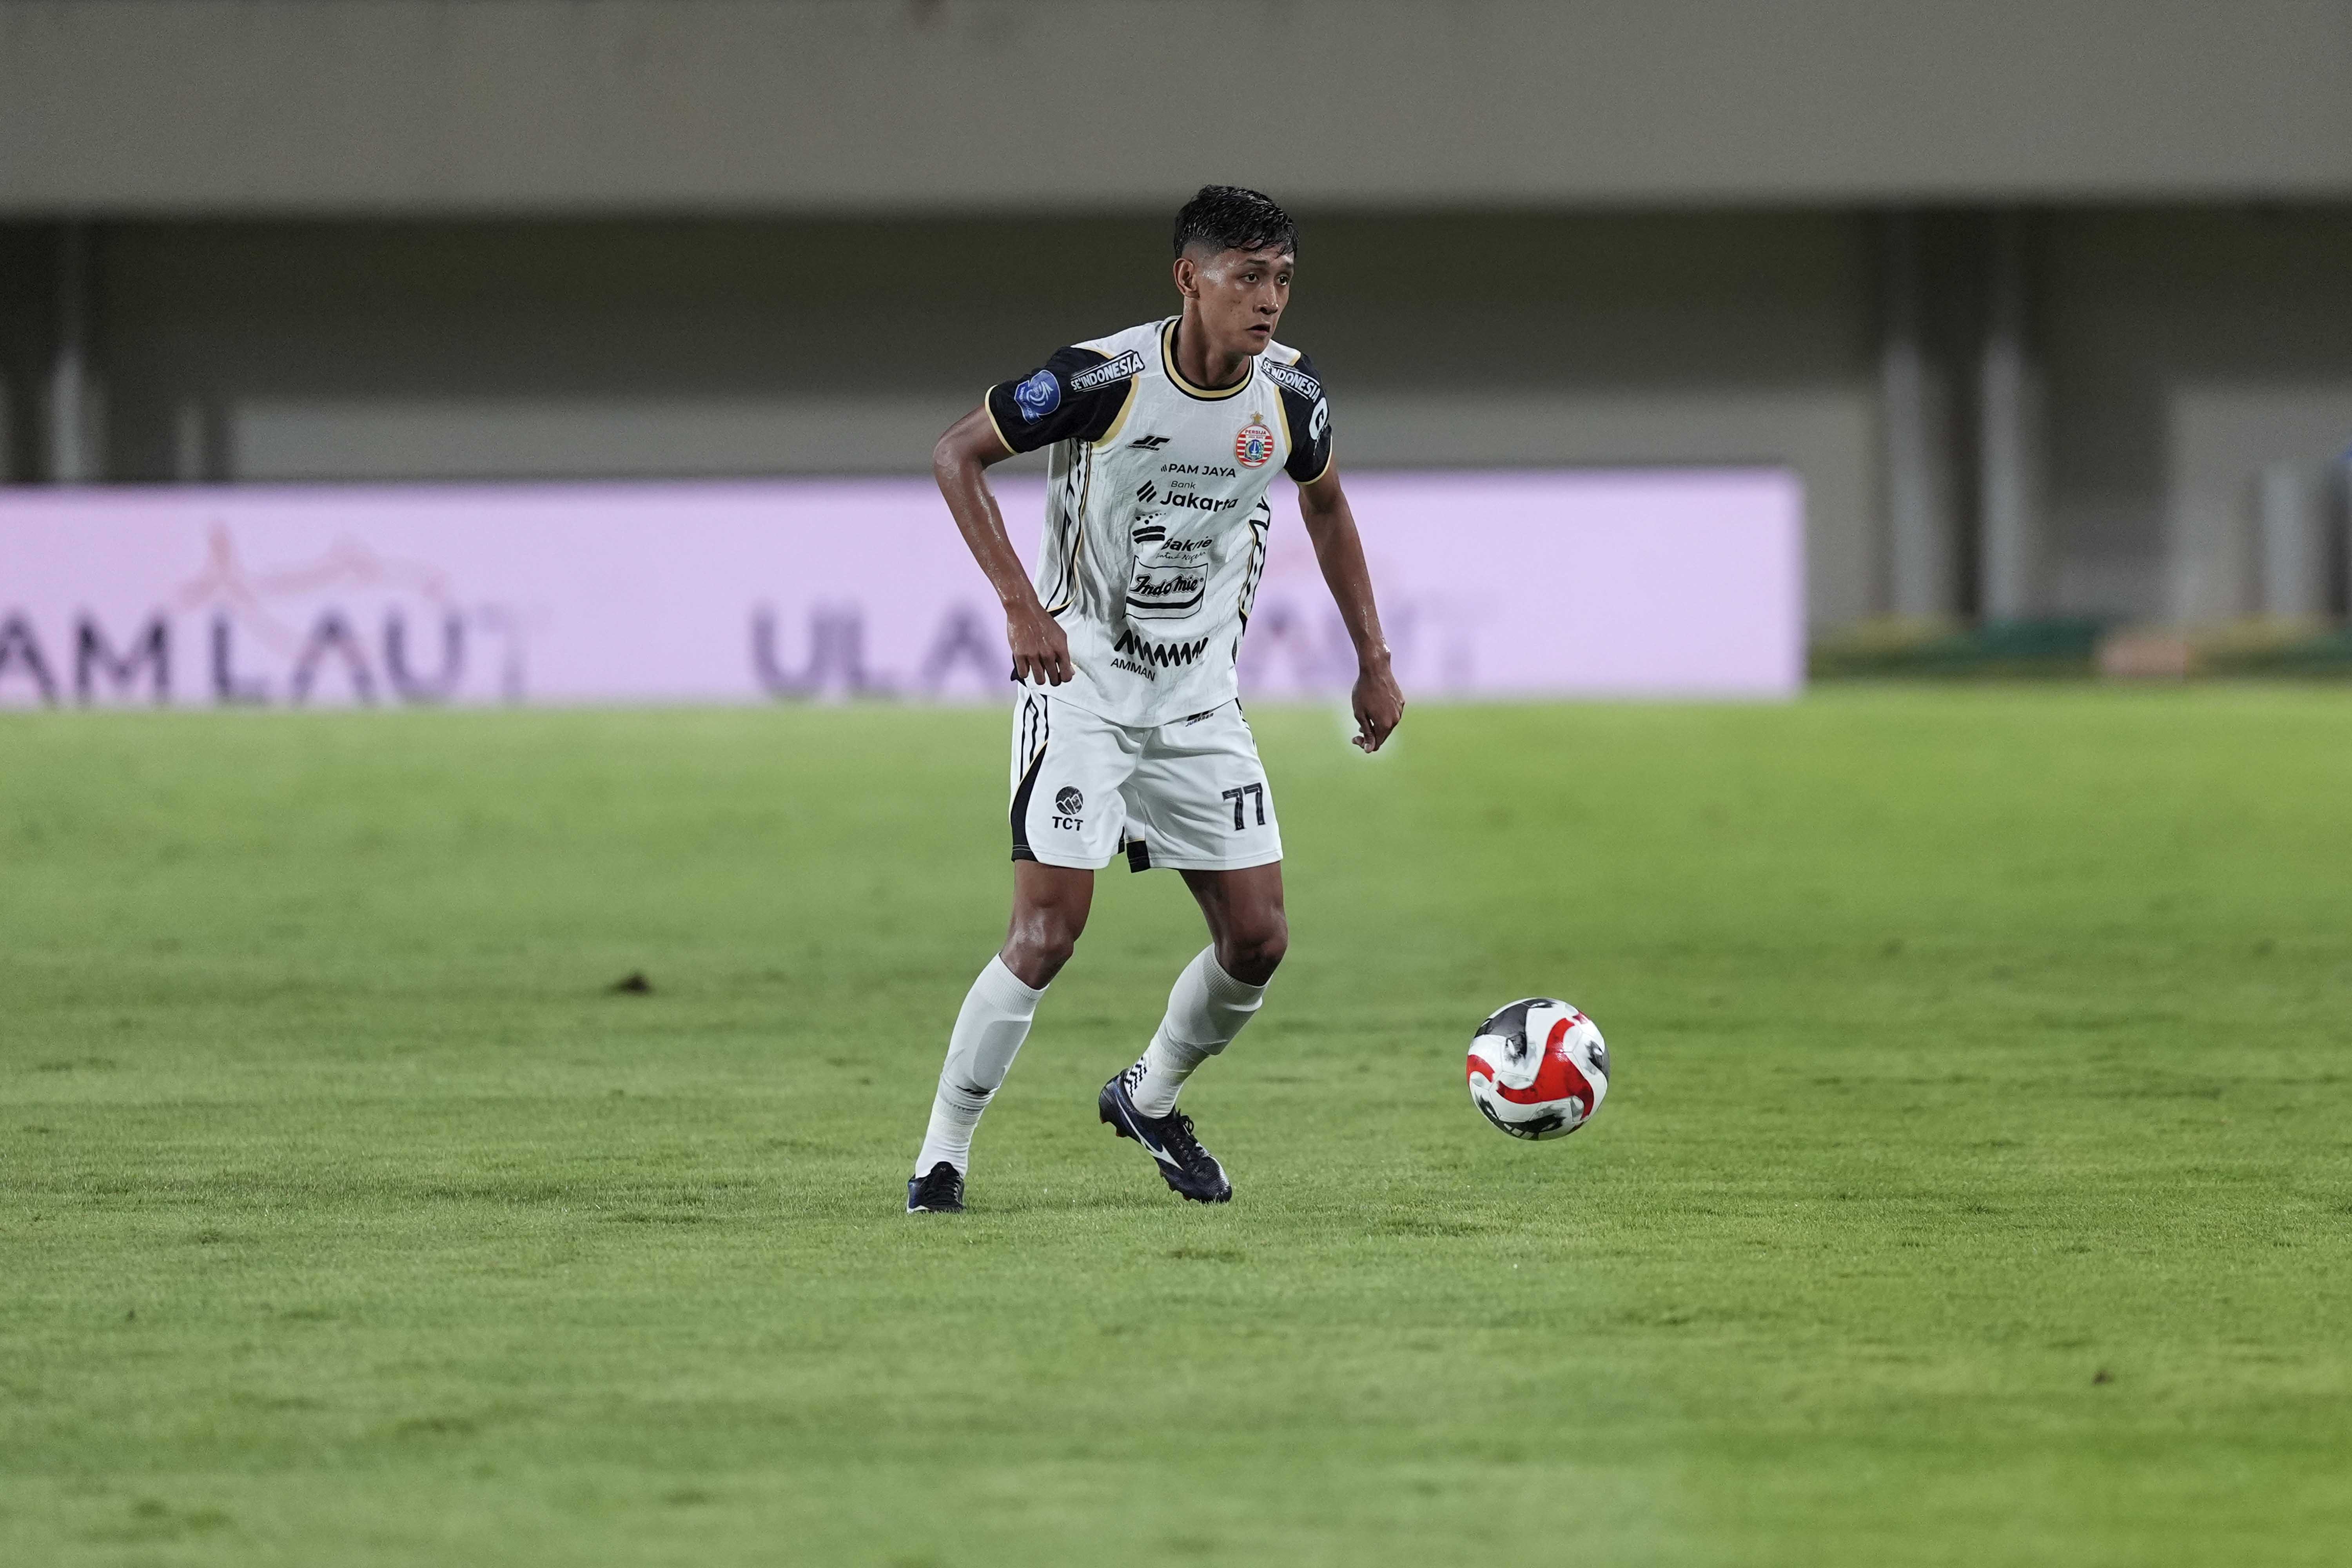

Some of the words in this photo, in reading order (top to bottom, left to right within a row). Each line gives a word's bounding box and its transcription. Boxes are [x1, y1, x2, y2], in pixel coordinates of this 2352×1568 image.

[1071, 353, 1144, 390] SE'INDONESIA
[1168, 463, 1199, 474] PAM
[1201, 466, 1236, 478] JAYA
[1171, 480, 1196, 489] Bank
[1160, 491, 1239, 512] Jakarta
[1161, 536, 1212, 552] Bakrie
[1129, 575, 1200, 597] Indomie
[1110, 658, 1155, 681] AMMAN
[1222, 782, 1266, 831] 77
[1052, 816, 1083, 831] TCT
